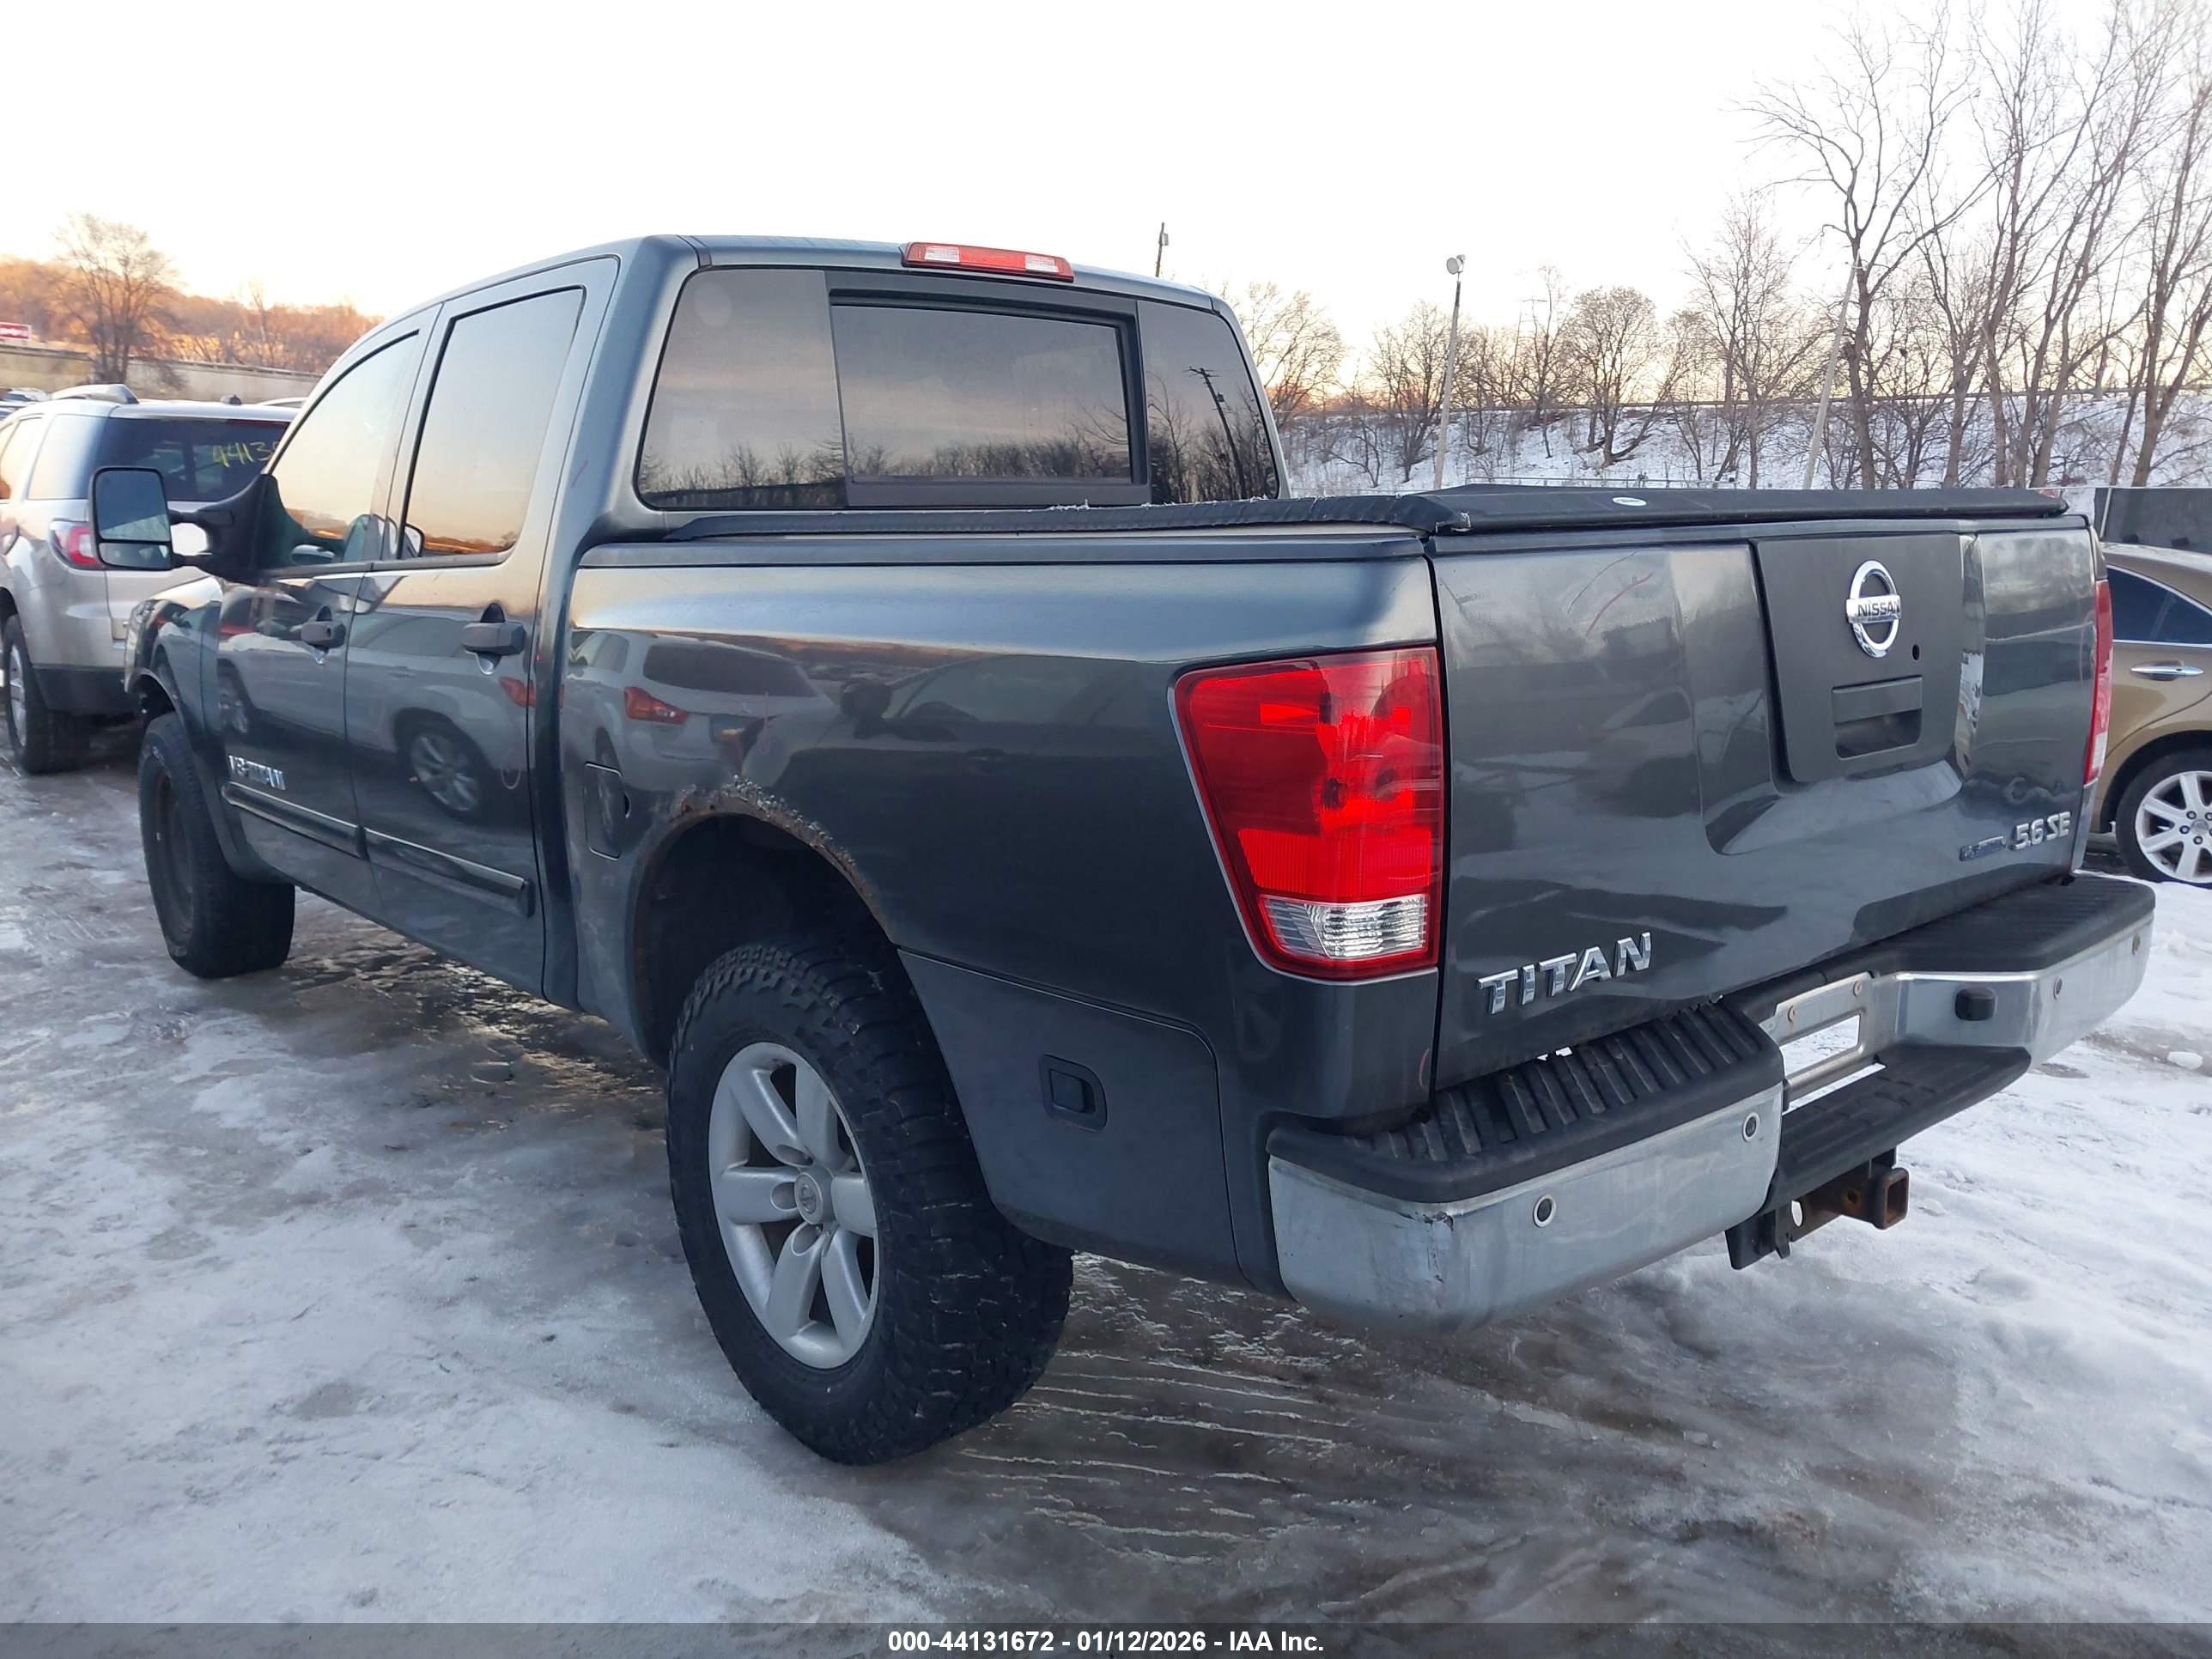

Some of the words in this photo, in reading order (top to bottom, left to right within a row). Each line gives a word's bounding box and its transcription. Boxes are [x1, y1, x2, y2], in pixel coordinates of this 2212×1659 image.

[1857, 599, 1900, 617] NISSAN
[2046, 811, 2071, 838] SE
[1476, 931, 1652, 1015] TITAN
